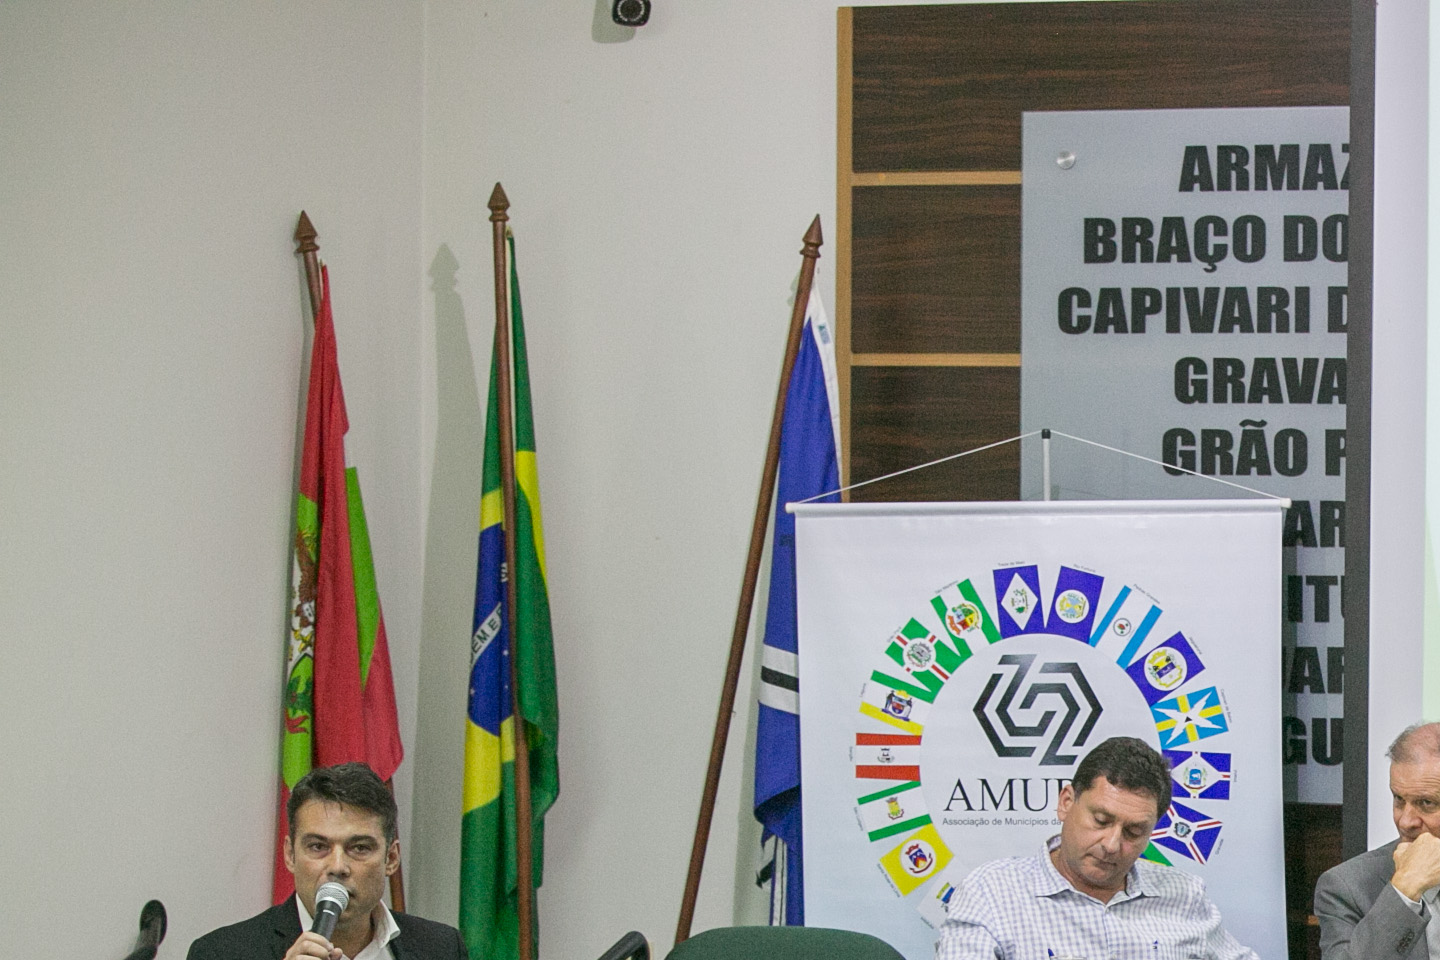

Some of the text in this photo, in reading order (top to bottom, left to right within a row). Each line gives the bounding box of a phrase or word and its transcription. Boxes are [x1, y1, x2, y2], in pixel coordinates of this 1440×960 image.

[1083, 215, 1266, 273] BRAÇO
[1058, 286, 1310, 334] CAPIVARI
[1174, 356, 1347, 405] GRAVA
[1162, 419, 1308, 477] GRÃO
[942, 818, 989, 827] Associação
[1005, 818, 1048, 827] Municípios
